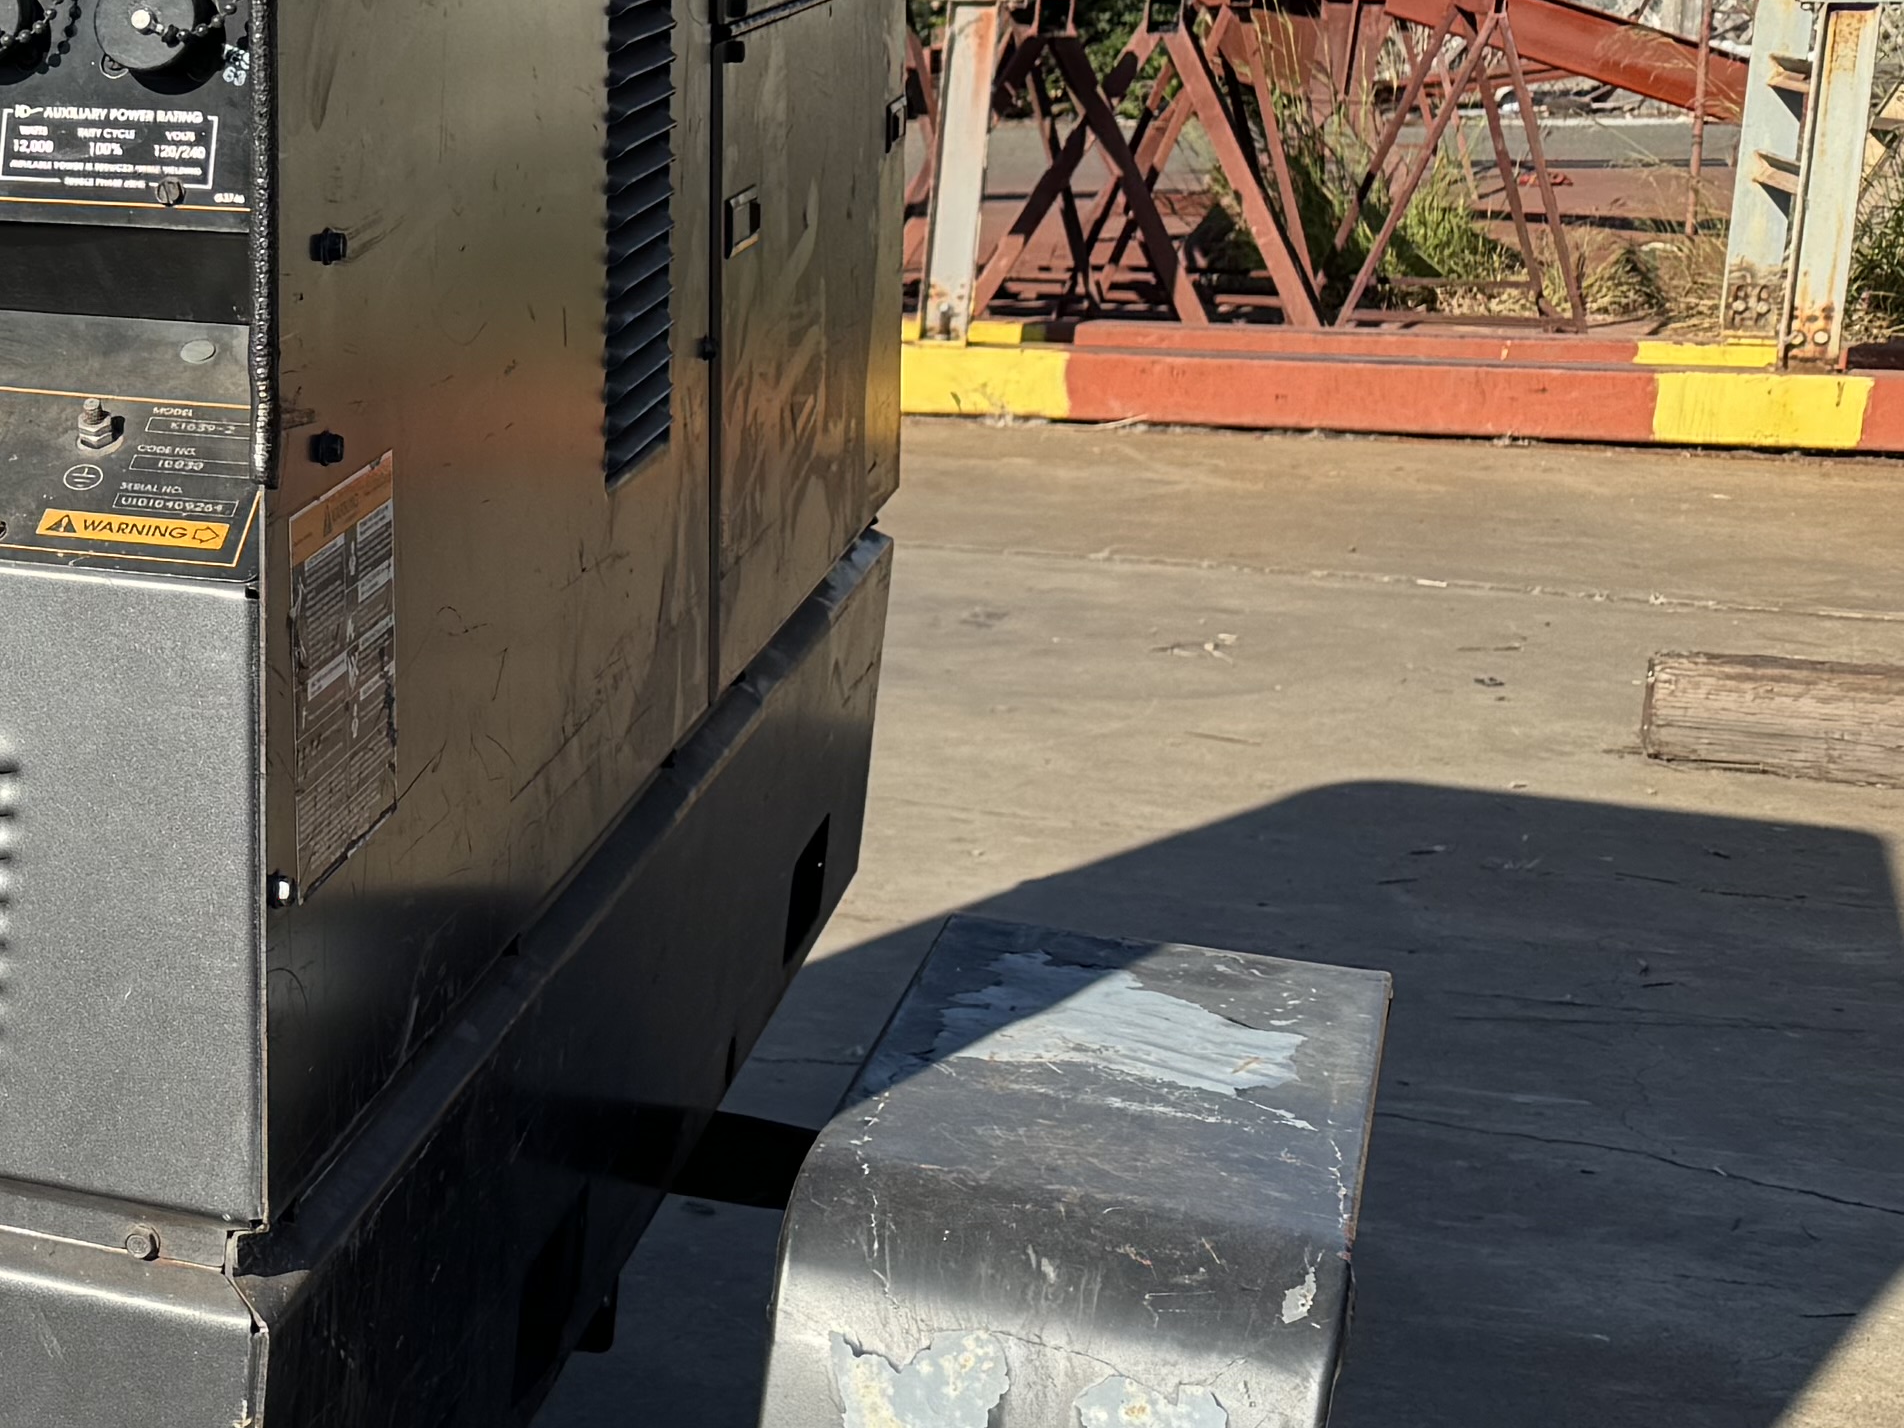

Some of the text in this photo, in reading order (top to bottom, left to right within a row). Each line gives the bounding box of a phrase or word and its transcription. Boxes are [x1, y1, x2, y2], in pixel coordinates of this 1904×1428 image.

[43, 107, 203, 124] AUXILIARY POWER RATING
[153, 144, 206, 160] 120/240
[137, 444, 172, 455] CODE
[119, 481, 158, 492] SERIAL
[83, 518, 188, 539] WARNING
